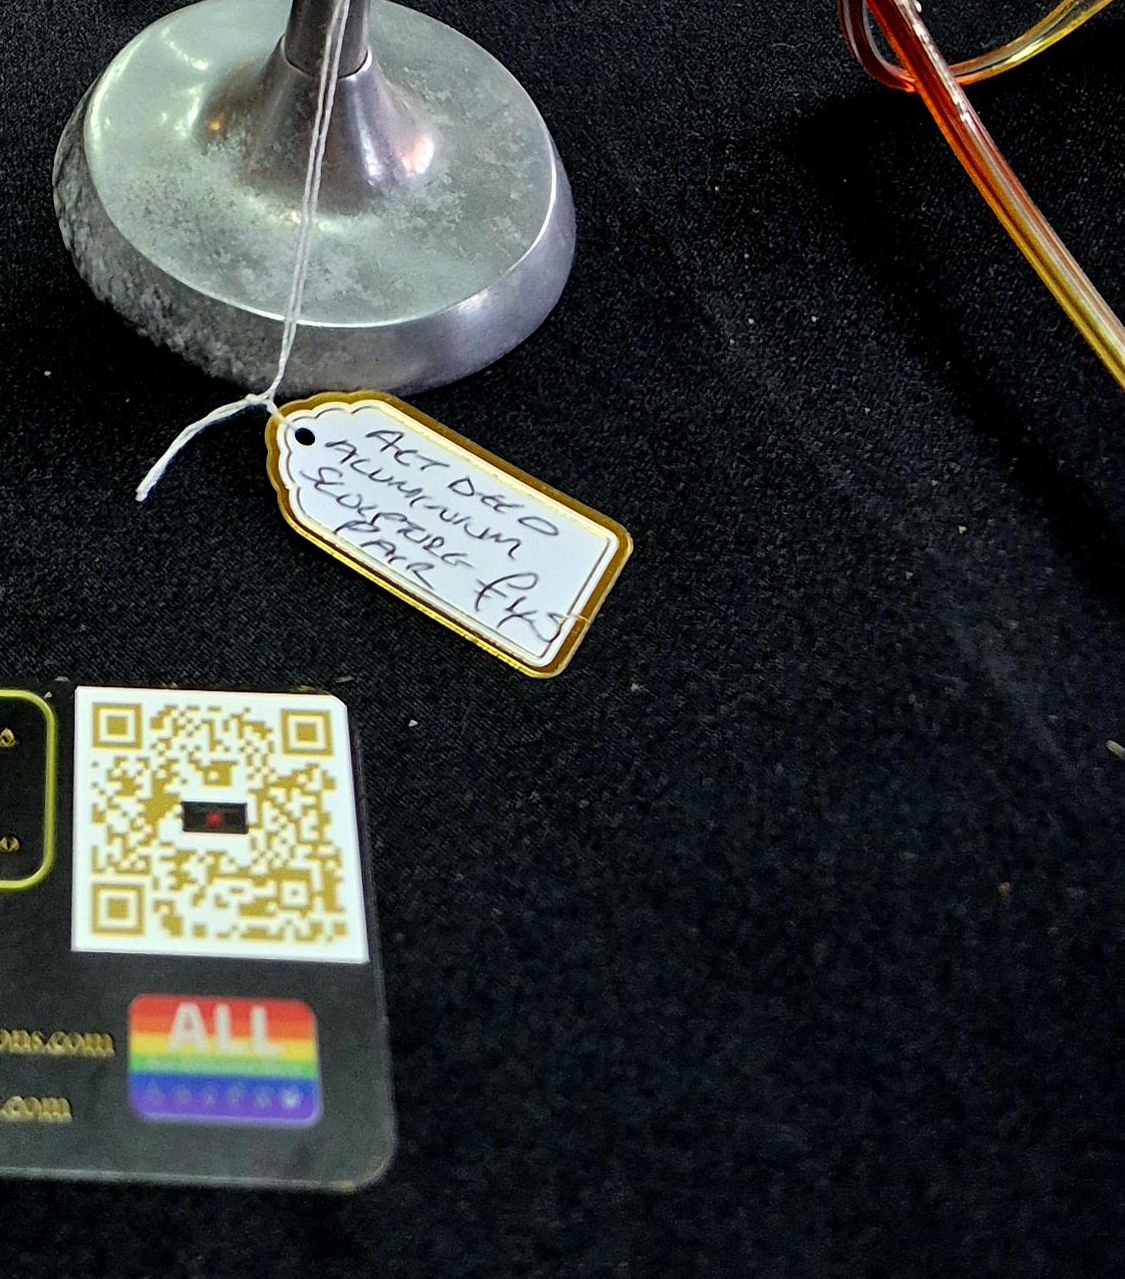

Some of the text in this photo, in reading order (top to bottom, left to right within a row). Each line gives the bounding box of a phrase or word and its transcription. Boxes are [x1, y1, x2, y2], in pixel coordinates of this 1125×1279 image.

[324, 439, 522, 561] ALUMINIUM
[446, 475, 560, 538] DECO
[332, 519, 435, 591] PAIR
[168, 1001, 285, 1058] ALL
